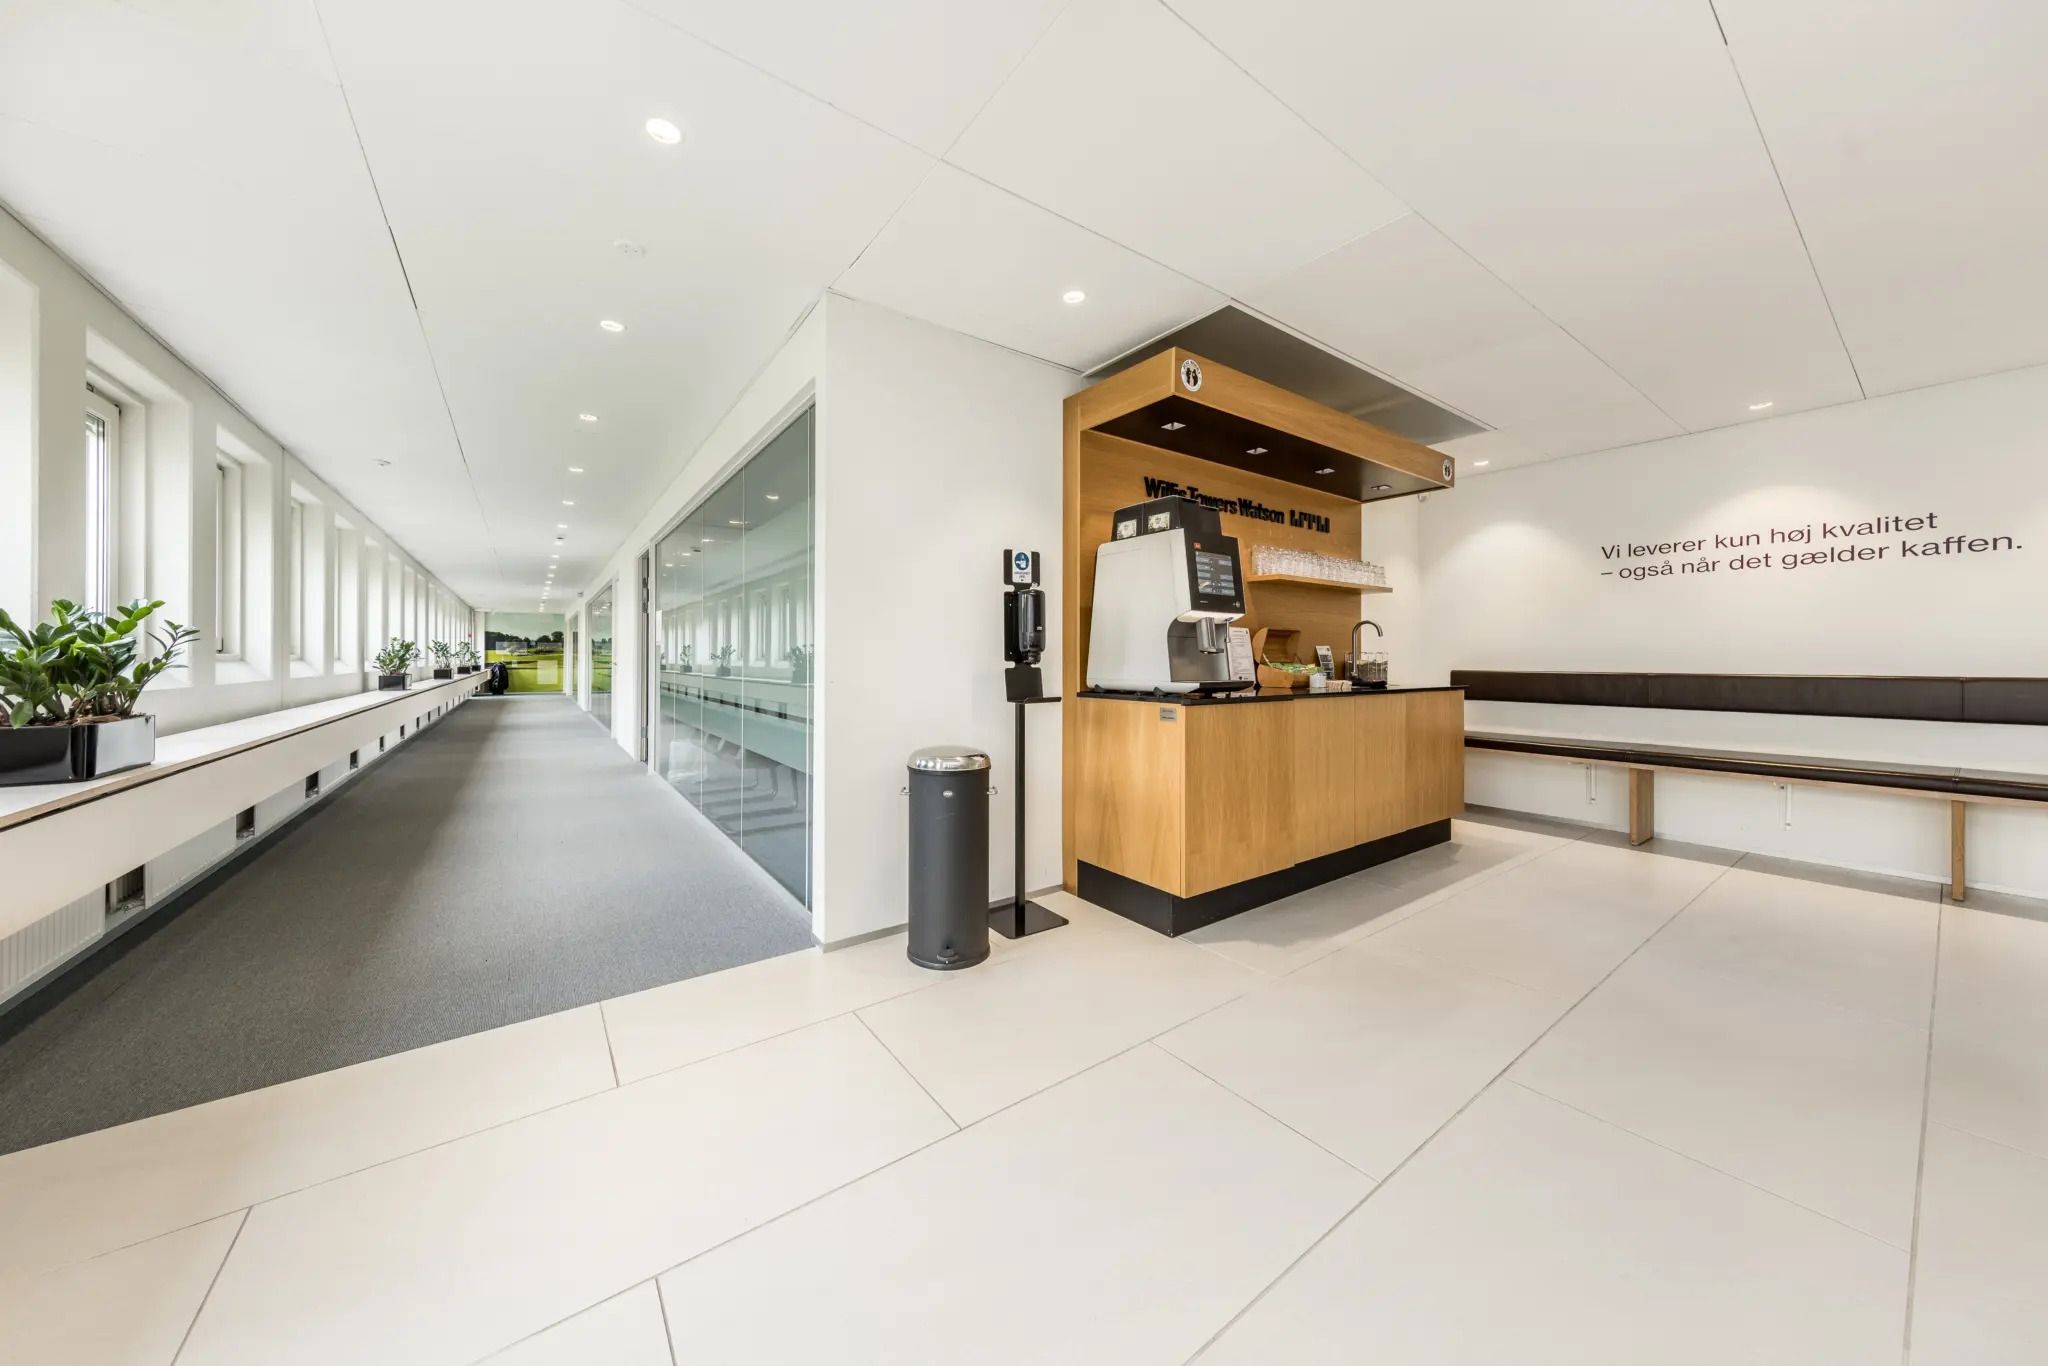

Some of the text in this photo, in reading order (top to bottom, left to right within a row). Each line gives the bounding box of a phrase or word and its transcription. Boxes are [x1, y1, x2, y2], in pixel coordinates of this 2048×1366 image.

[1238, 498, 1285, 525] Watson
[1601, 511, 1939, 560] Vi leverer kun høj kvalitet
[1618, 560, 1675, 581] også
[1681, 556, 1721, 575] når
[1728, 552, 1773, 571] det
[1781, 544, 1891, 570] gælder
[1901, 534, 2024, 558] kaffen.
